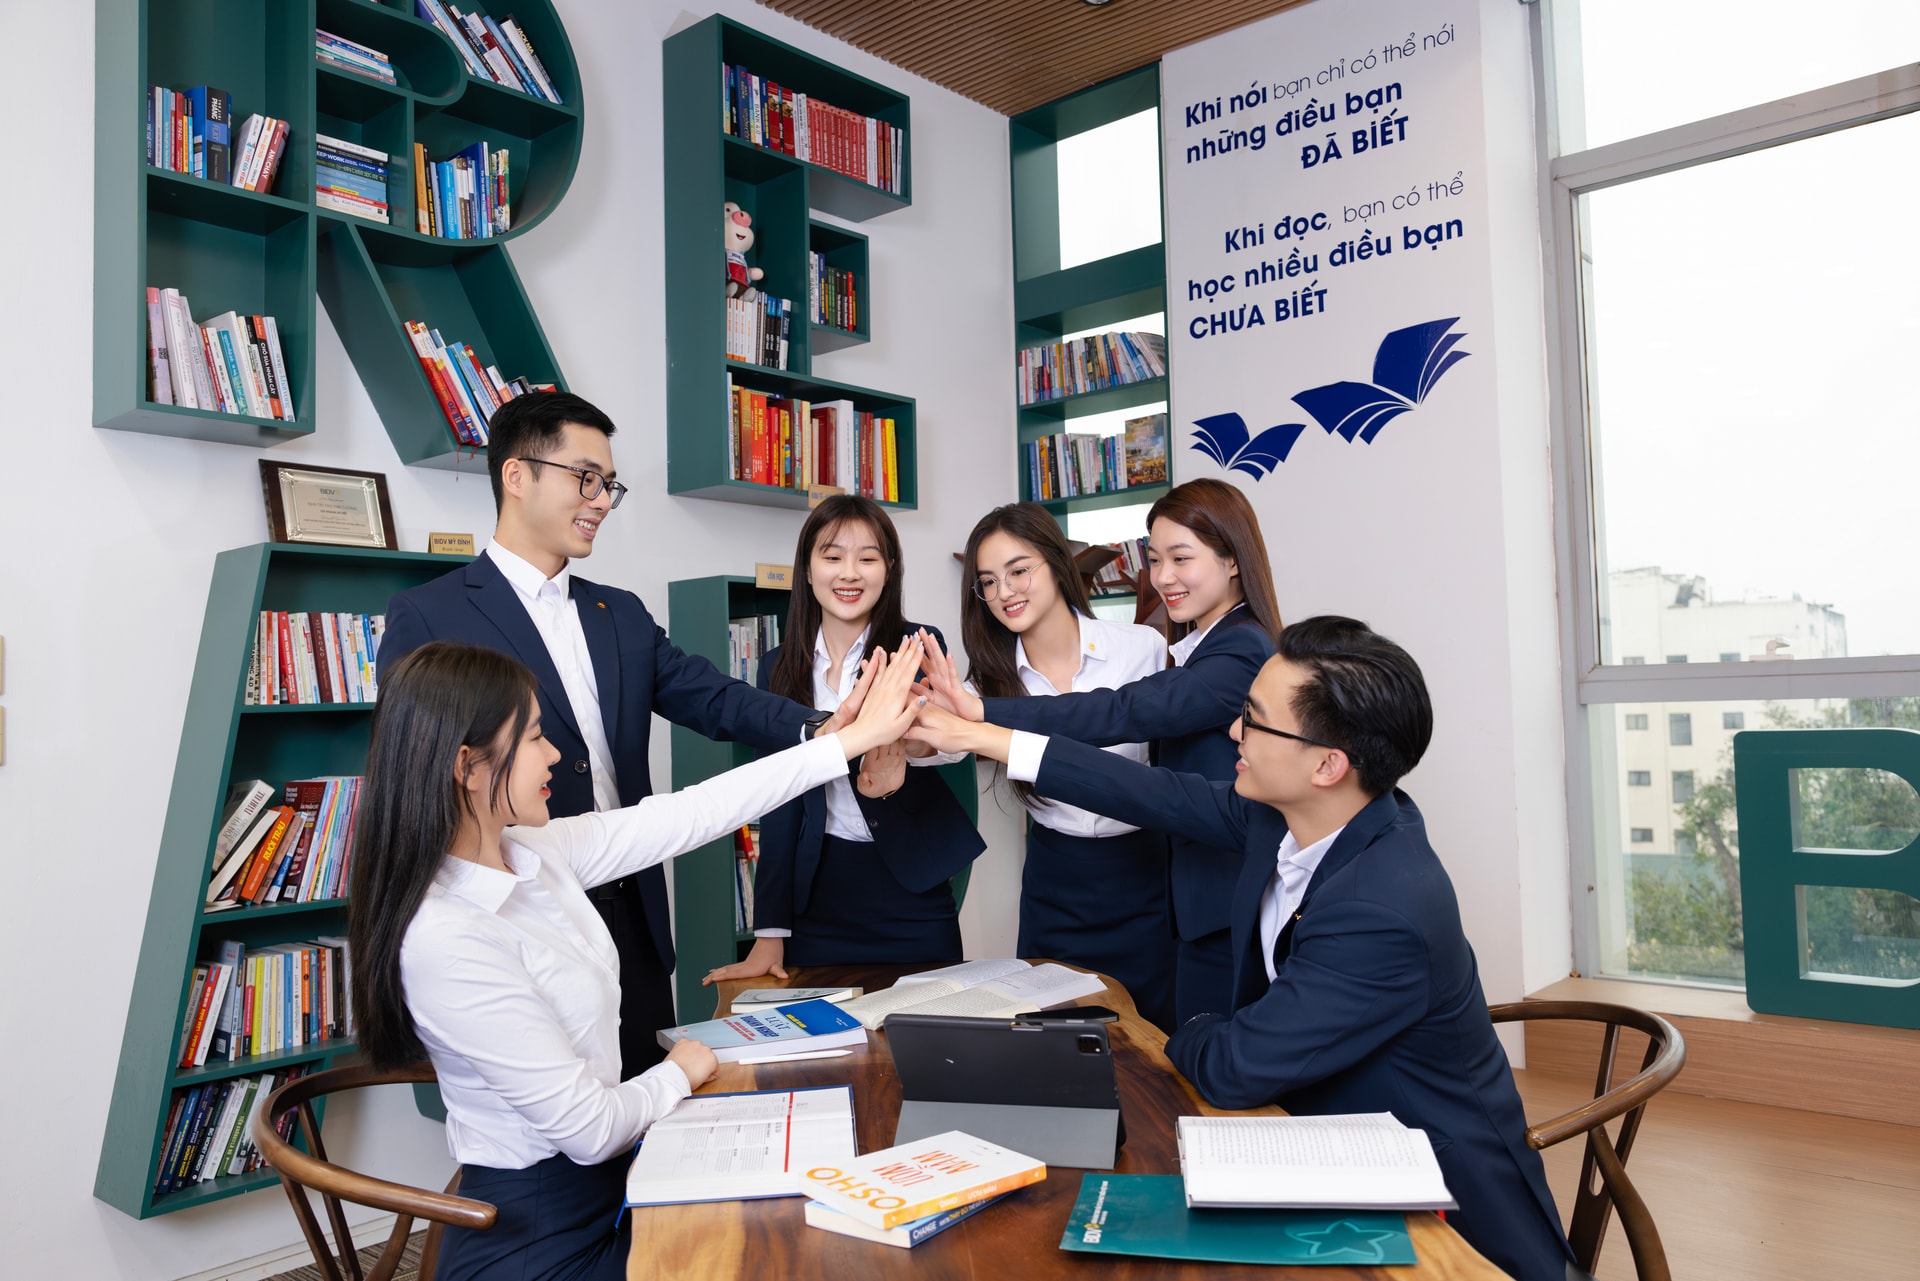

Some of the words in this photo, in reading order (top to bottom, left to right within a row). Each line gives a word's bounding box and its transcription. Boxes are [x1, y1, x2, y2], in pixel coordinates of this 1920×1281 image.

[1185, 97, 1222, 128] Khi
[1230, 79, 1267, 115] nói
[1273, 75, 1311, 102] bạn
[1316, 57, 1345, 86] chỉ
[1350, 49, 1377, 75] có
[1382, 31, 1416, 64] thể
[1423, 23, 1455, 51] nói
[1186, 124, 1266, 164] những
[1275, 97, 1335, 137] điều
[1345, 82, 1402, 117] bạn
[1301, 131, 1343, 170] ĐÃ
[1225, 223, 1264, 254] Khi
[1344, 198, 1385, 224] bạn
[1392, 185, 1420, 211] có
[1427, 171, 1464, 201] thể
[1188, 274, 1236, 304] học
[1245, 247, 1319, 289] nhiều
[1329, 228, 1392, 268] điều
[1403, 218, 1464, 252] bạn
[1189, 303, 1266, 339] CHƯA
[806, 1167, 907, 1210] OSHO
[912, 1221, 937, 1240] CHANGE
